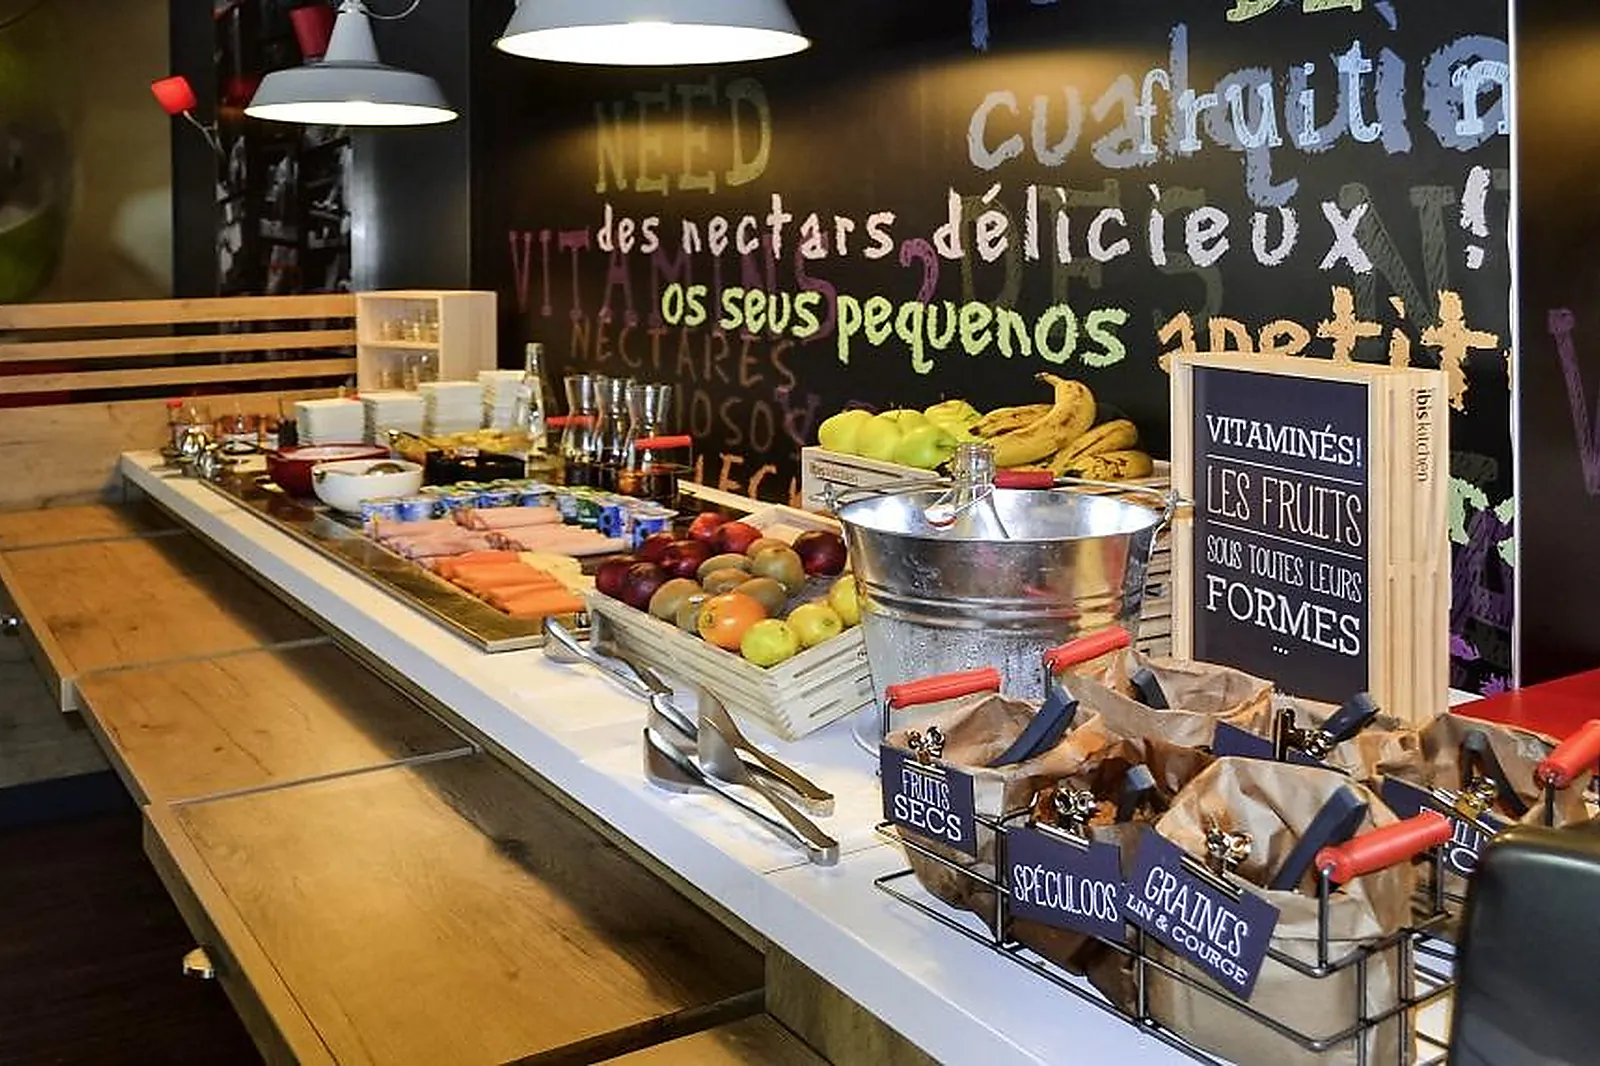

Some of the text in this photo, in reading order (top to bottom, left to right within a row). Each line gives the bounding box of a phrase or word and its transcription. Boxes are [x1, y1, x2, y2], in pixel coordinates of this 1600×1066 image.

[594, 74, 772, 196] NEED
[1134, 38, 1384, 153] fruit
[597, 202, 661, 254] des
[681, 193, 897, 261] nectars
[933, 182, 1373, 275] délicieux
[660, 282, 1131, 376] os seus pequenos
[1205, 414, 1362, 468] VITAMINÉS!
[1416, 388, 1432, 482] ibis kitchen
[1206, 464, 1363, 547] LES FRUITS
[1206, 533, 1363, 603] SOUS TOUTES LEURS
[1206, 573, 1361, 657] FORMES
[894, 793, 963, 842] SECS
[902, 768, 950, 812] FRUITS
[1012, 862, 1119, 923] SPÉCULOOS
[1144, 865, 1249, 958] GRAINES
[1125, 893, 1250, 985] LIN & COURGE
